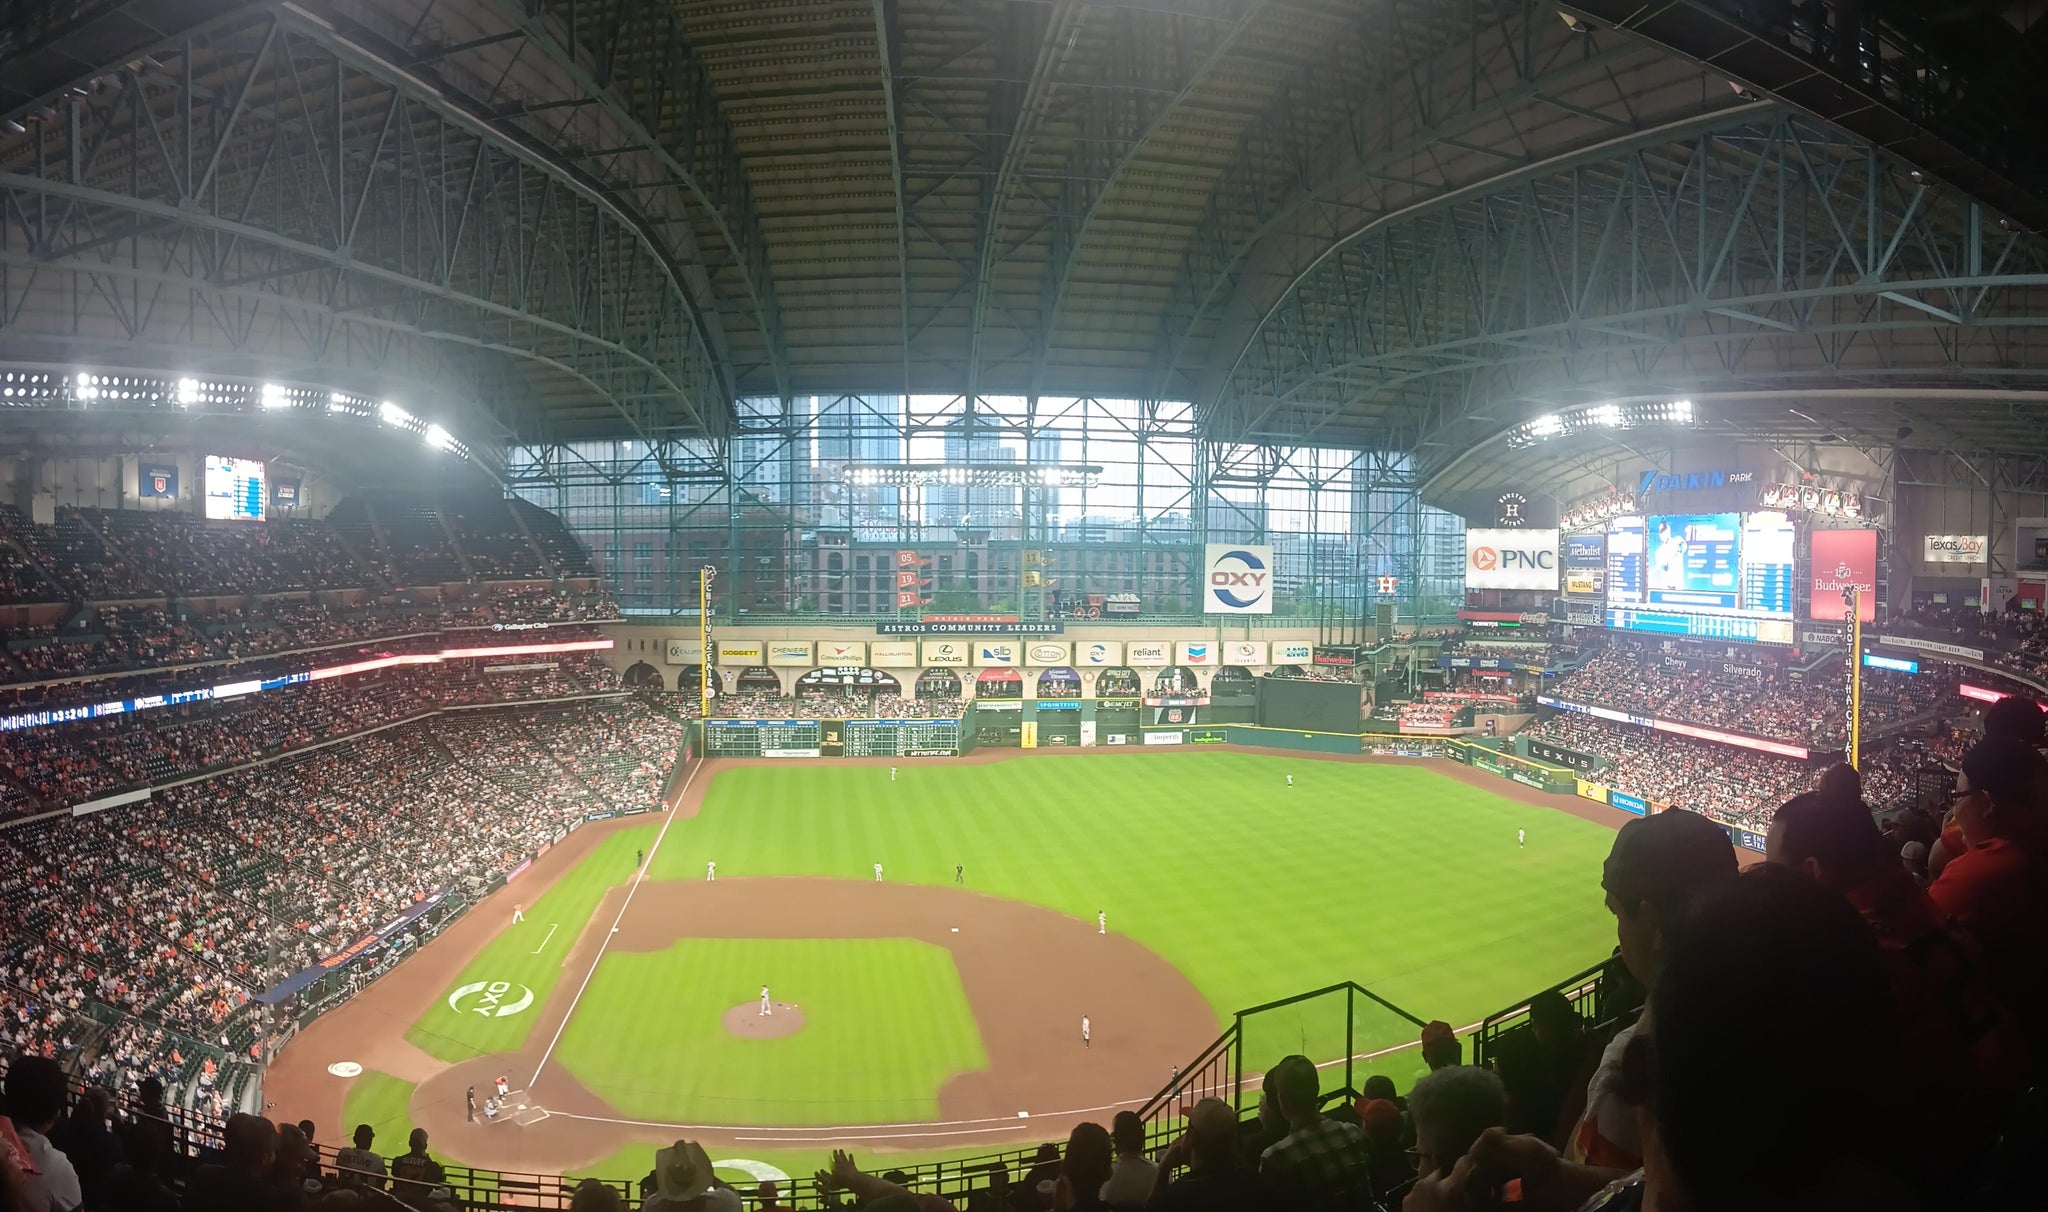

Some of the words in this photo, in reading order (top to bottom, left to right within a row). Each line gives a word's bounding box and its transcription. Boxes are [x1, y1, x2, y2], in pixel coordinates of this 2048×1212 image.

[1656, 471, 1726, 491] DAIKIN
[1730, 472, 1752, 482] PARK
[1499, 493, 1527, 503] HOUSTON
[1806, 488, 1813, 500] 5
[1506, 504, 1518, 517] H
[1500, 518, 1525, 526] ASTROS
[1570, 545, 1600, 556] Methodist
[1929, 537, 1958, 550] Texas
[1962, 538, 1983, 554] Bay
[901, 554, 912, 562] 05
[1026, 553, 1036, 562] 17
[1500, 550, 1553, 569] PNC
[1212, 572, 1266, 586] OXY
[1572, 581, 1592, 589] MUSTANG
[1520, 612, 1548, 624] Coca-Cola
[1845, 612, 1855, 652] ROOT
[994, 646, 1011, 655] slb
[1133, 648, 1161, 656] reliant
[1286, 647, 1309, 657] LNG
[1314, 655, 1353, 664] Budweiser
[1664, 656, 1687, 669] Chevy
[1723, 664, 1762, 677] Silverado
[1845, 674, 1853, 705] THA
[1532, 746, 1588, 767] LEXUS
[1619, 799, 1644, 810] HONDA
[472, 981, 511, 1017] OXY
